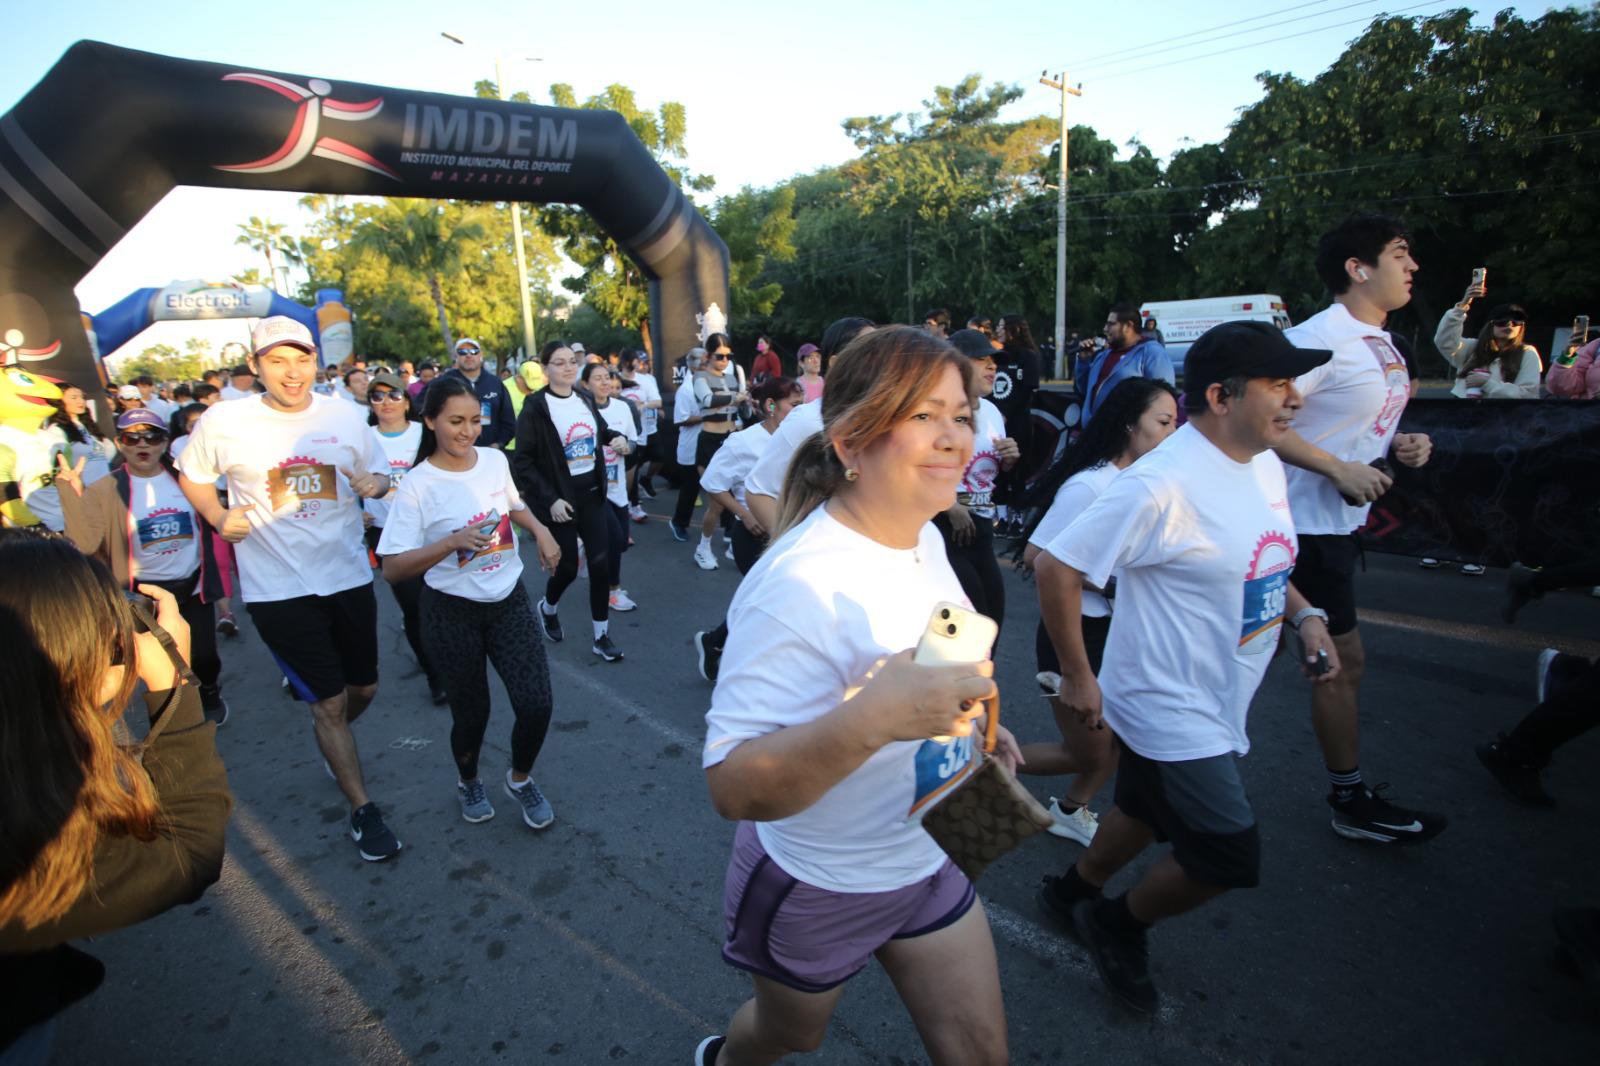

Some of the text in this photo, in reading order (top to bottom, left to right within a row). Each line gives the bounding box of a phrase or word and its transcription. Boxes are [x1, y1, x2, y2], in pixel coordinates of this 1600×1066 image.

[402, 103, 577, 159] IMDEM
[400, 151, 573, 174] INSTITUTO MUNICIPAL DEL DEPORTE
[285, 473, 322, 496] 203
[151, 521, 180, 539] 329
